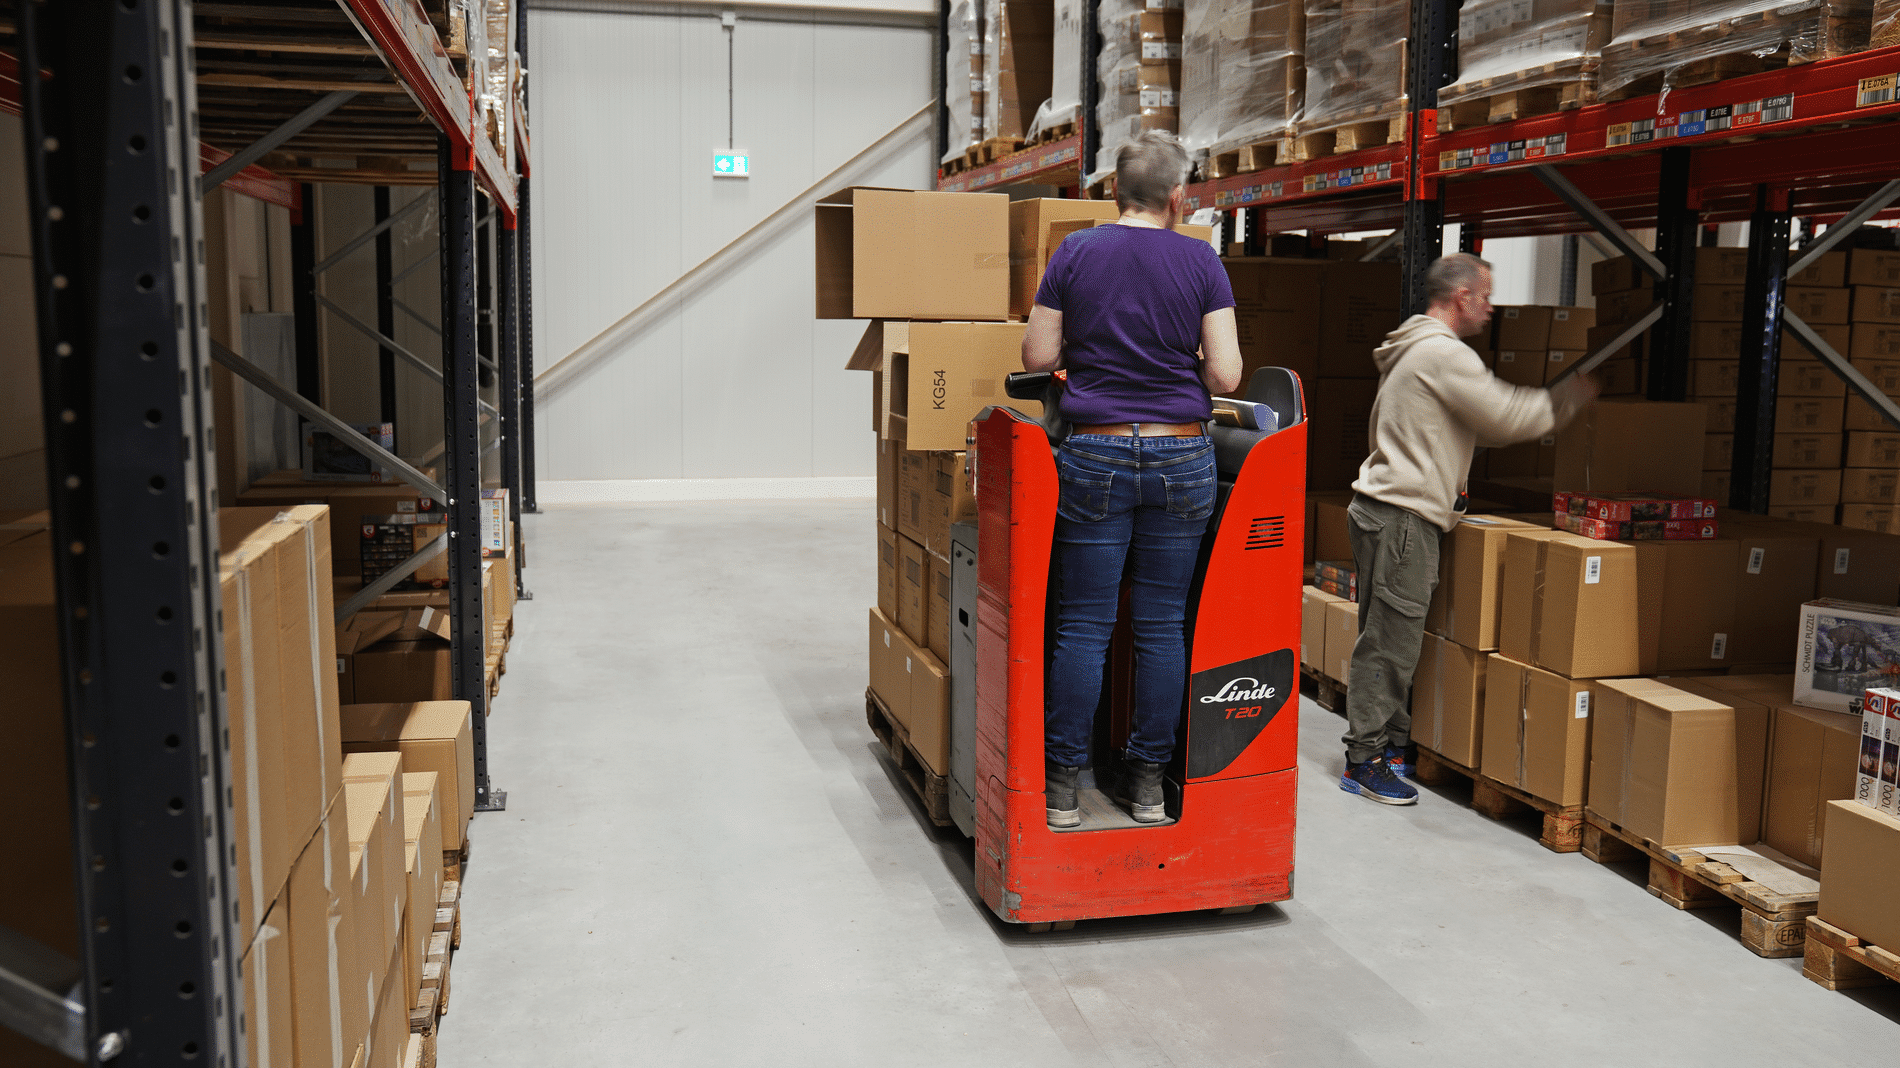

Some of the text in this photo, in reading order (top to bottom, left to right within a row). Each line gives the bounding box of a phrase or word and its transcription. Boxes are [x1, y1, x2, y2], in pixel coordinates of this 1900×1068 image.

[1867, 78, 1889, 89] E.076A
[933, 369, 946, 410] KG54
[1802, 613, 1815, 673] SCHMIDT PUZZLE
[1199, 677, 1276, 704] Linde
[1859, 776, 1870, 801] 1000
[1882, 784, 1893, 809] 1000
